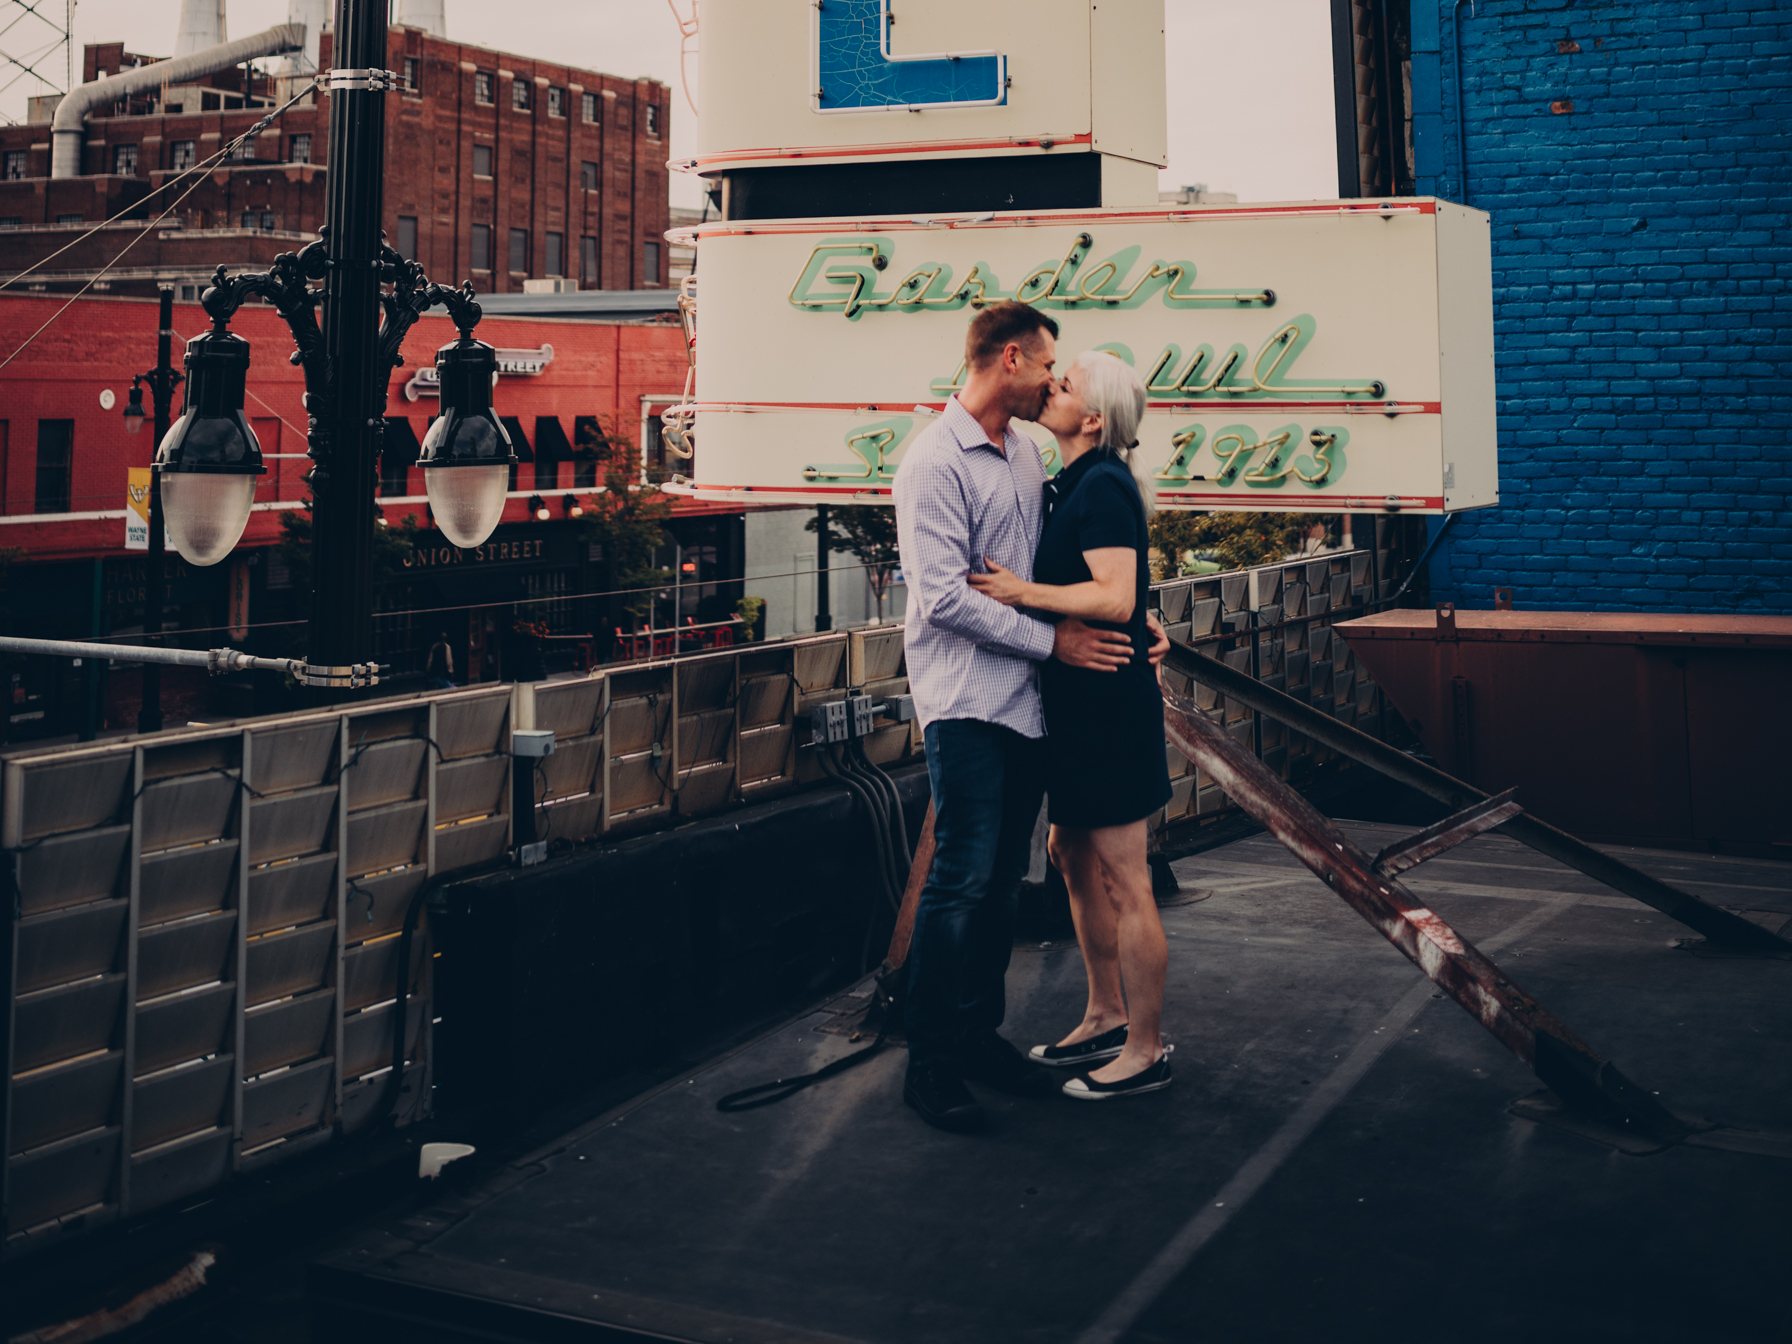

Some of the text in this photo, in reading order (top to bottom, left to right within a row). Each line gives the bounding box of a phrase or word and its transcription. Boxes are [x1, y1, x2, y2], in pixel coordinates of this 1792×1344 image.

[787, 230, 1277, 320] Garden
[496, 360, 542, 373] TREET
[1152, 422, 1350, 490] 1913
[127, 526, 147, 534] WAYNE
[129, 534, 146, 542] STATE
[475, 540, 543, 562] STREET
[107, 558, 187, 584] HARER
[107, 584, 172, 605] FLORT
